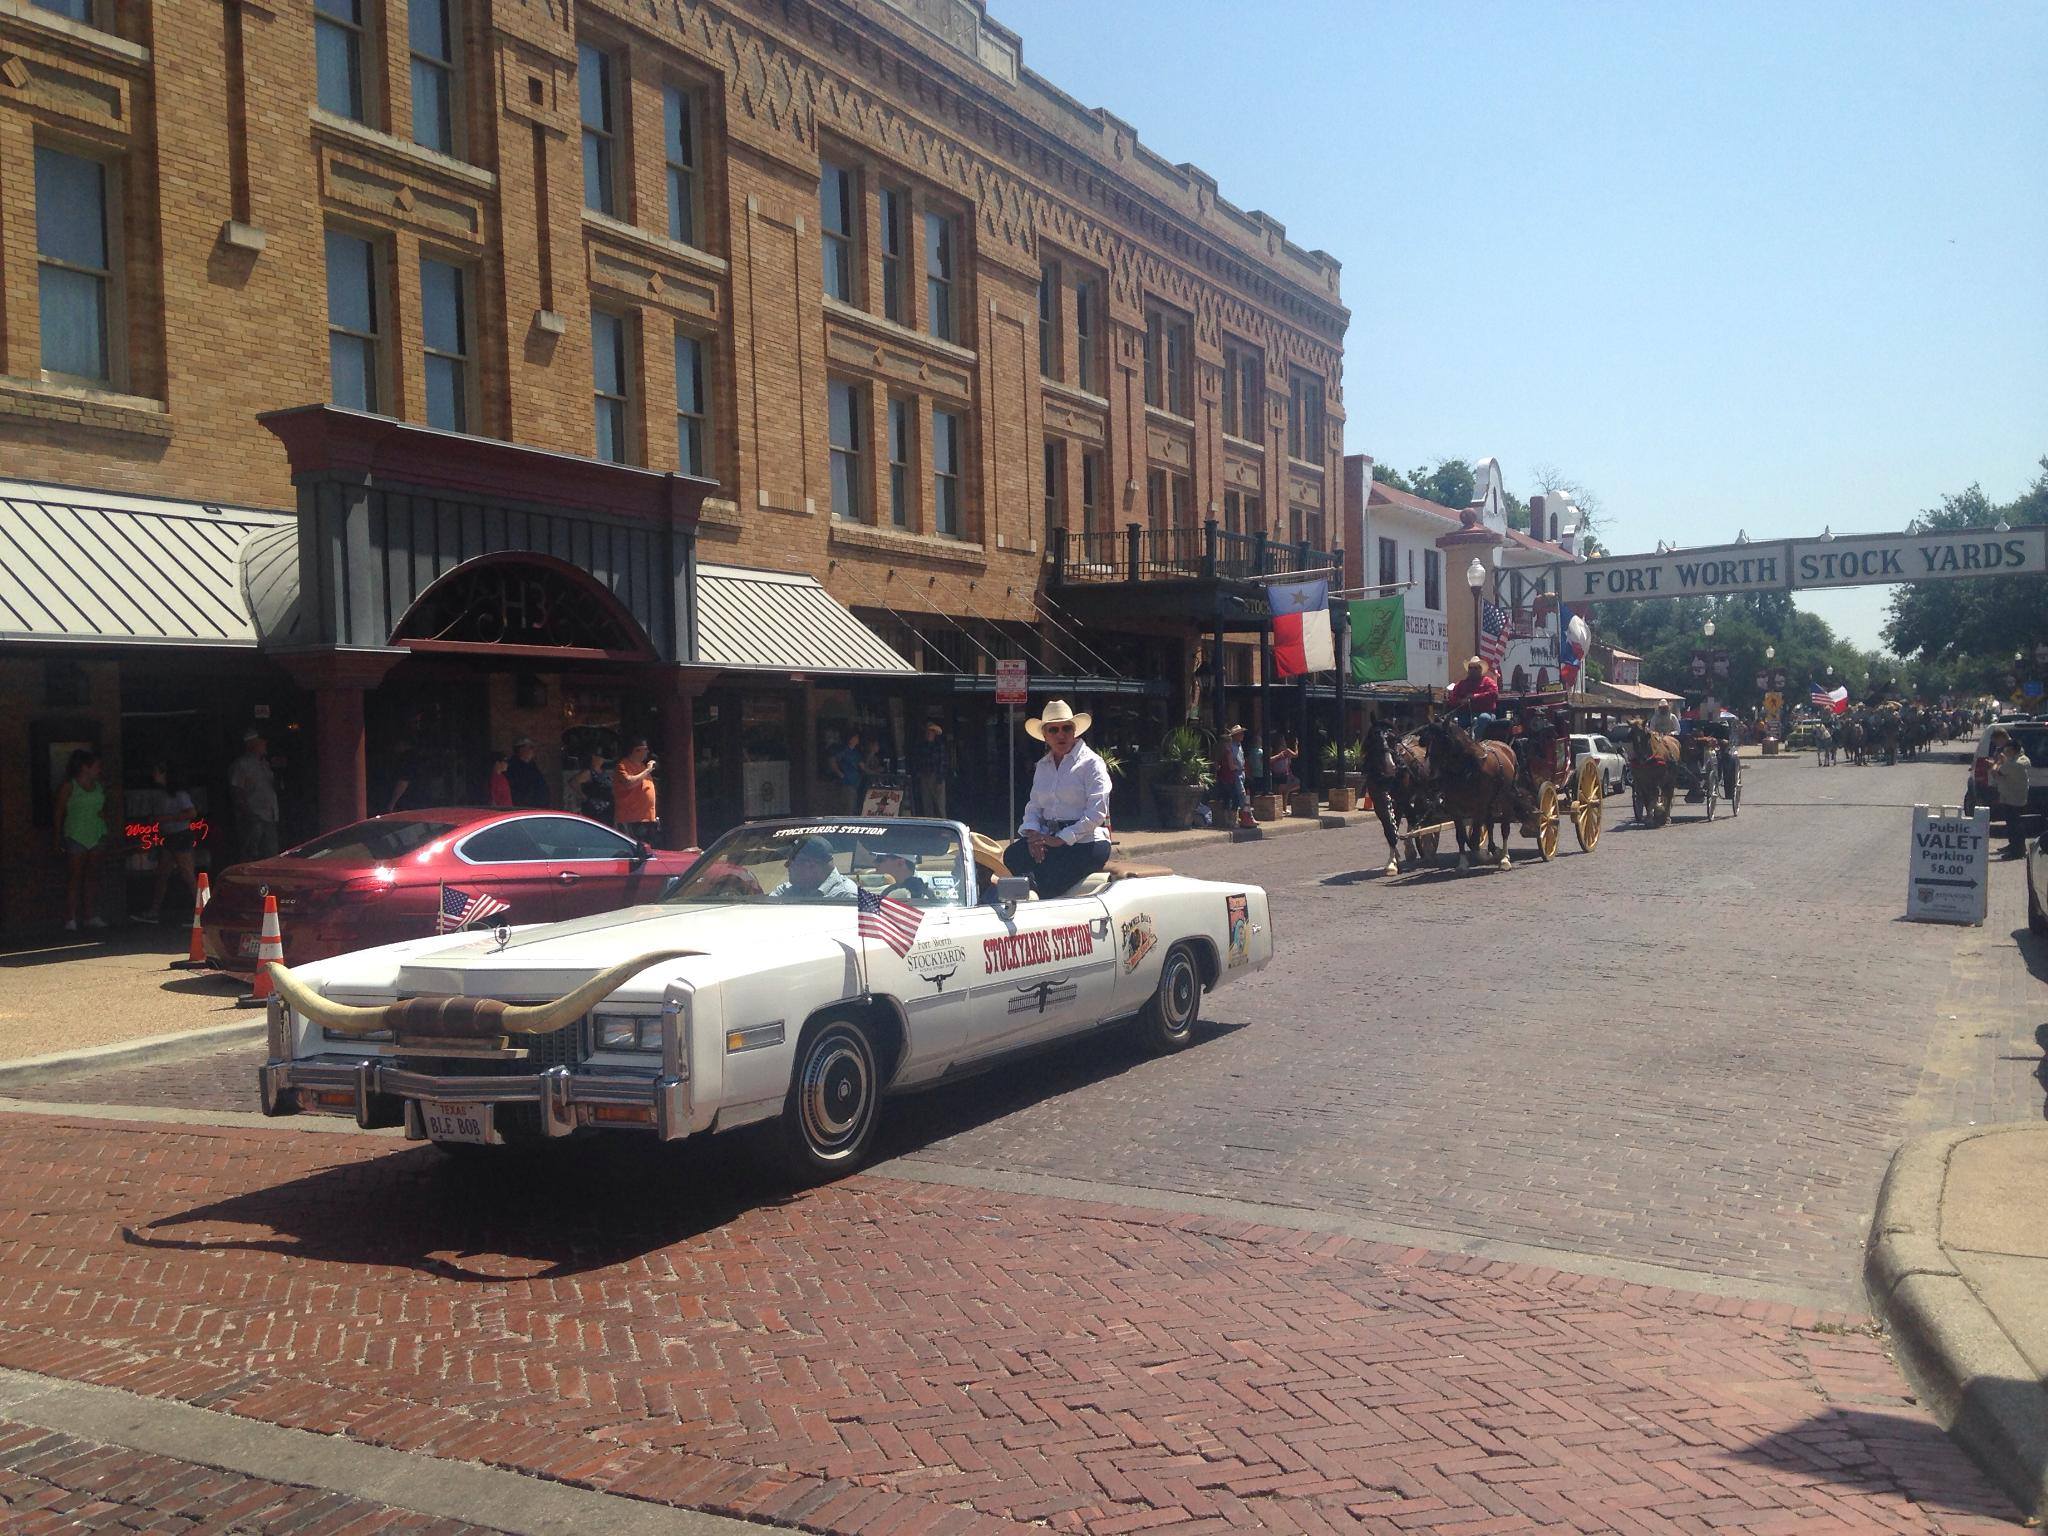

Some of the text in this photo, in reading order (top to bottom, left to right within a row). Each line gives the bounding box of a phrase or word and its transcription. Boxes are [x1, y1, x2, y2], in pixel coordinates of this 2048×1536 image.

[1584, 539, 2027, 595] FORT WORTH STOCK YARDS
[1404, 615, 1435, 636] NCHER'S
[773, 825, 888, 838] STOCKYARDS STATION
[1929, 822, 1971, 834] Public
[1916, 833, 1982, 850] VALET
[1922, 849, 1974, 864] Parking
[1931, 863, 1964, 875] $8.00
[983, 929, 1051, 975] STOCKYARDS
[1051, 923, 1094, 960] STATION
[907, 946, 966, 972] STOCKYARDS
[440, 1104, 467, 1116] TEXAS
[430, 1116, 481, 1136] BLE BOB
